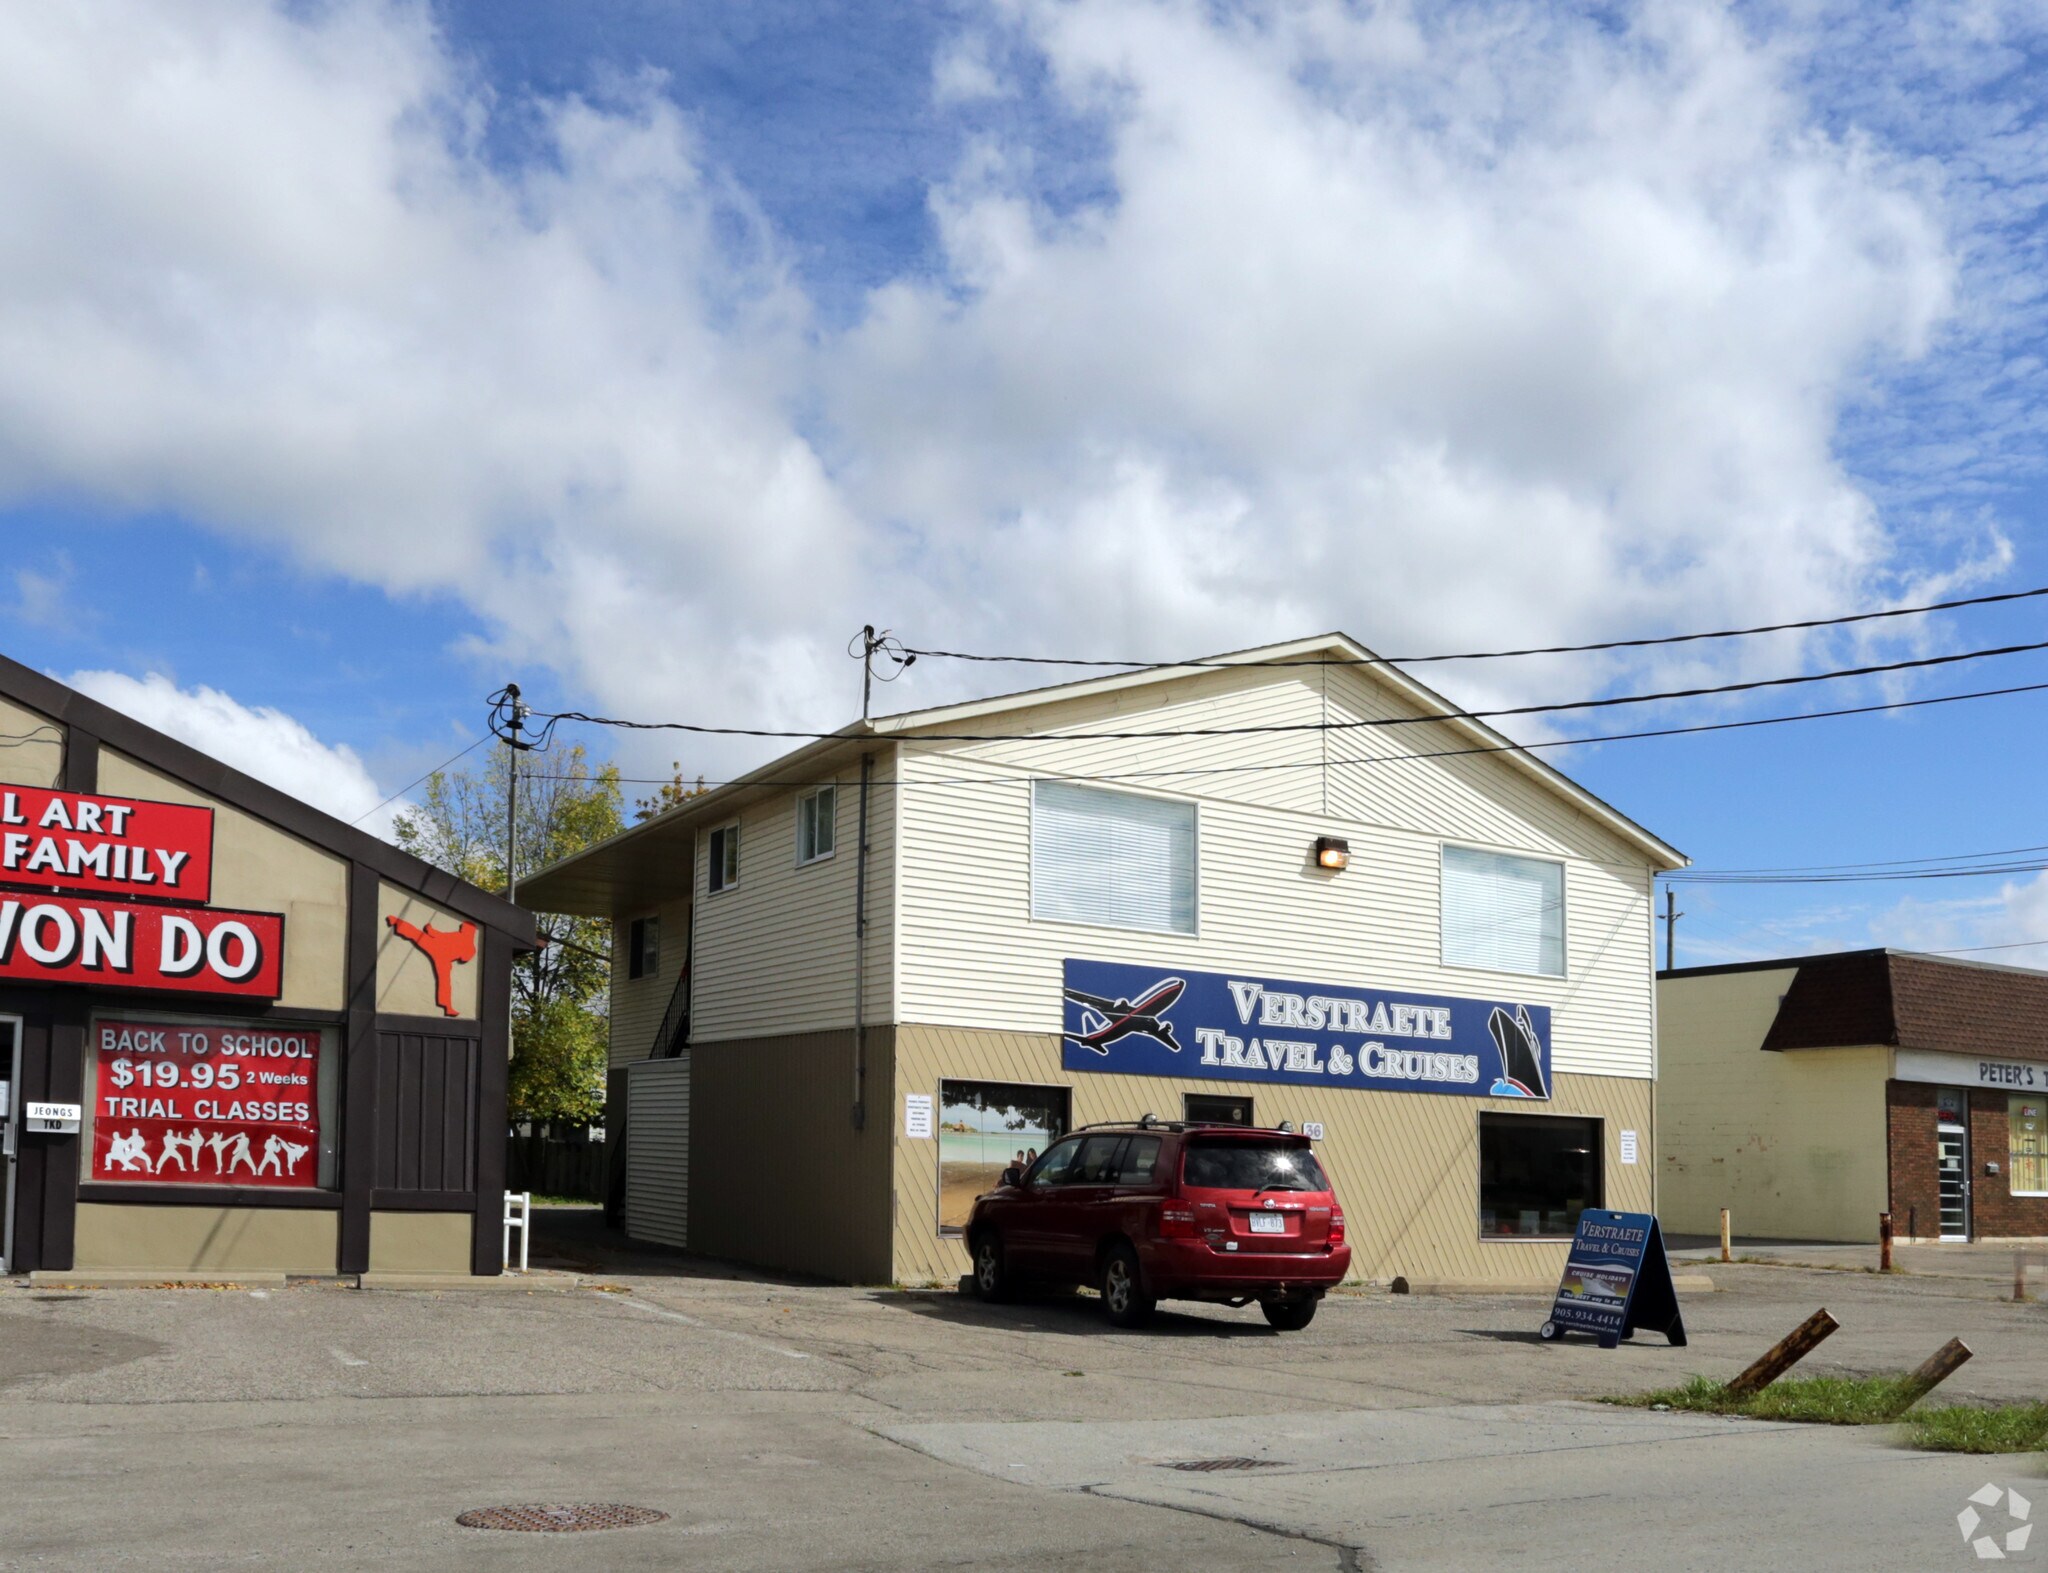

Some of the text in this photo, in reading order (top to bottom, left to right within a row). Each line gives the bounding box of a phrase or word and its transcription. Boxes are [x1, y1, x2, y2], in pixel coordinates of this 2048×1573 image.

[38, 798, 134, 836] ART
[3, 832, 190, 886] FAMILY
[0, 900, 260, 980] ON DO
[1227, 980, 1452, 1040] VERSTRAETE
[101, 1029, 313, 1059] BACK TO SCHOOL
[1195, 1027, 1480, 1084] TRAVEL & CRUISES
[110, 1057, 308, 1090] $19.95 2 Weeks
[1979, 1062, 2034, 1086] PETER'S
[34, 1106, 73, 1117] JEONGS
[104, 1096, 310, 1122] TRIAL CLASSES
[43, 1119, 62, 1130] TKD
[1305, 1124, 1322, 1137] 36
[1581, 1220, 1644, 1242] VERSTRAETE
[1575, 1239, 1640, 1257] TRAVEL & CRUISES
[1571, 1270, 1626, 1282] CRUISE HOLIDAYS
[1554, 1307, 1621, 1326] 905.934.4414
